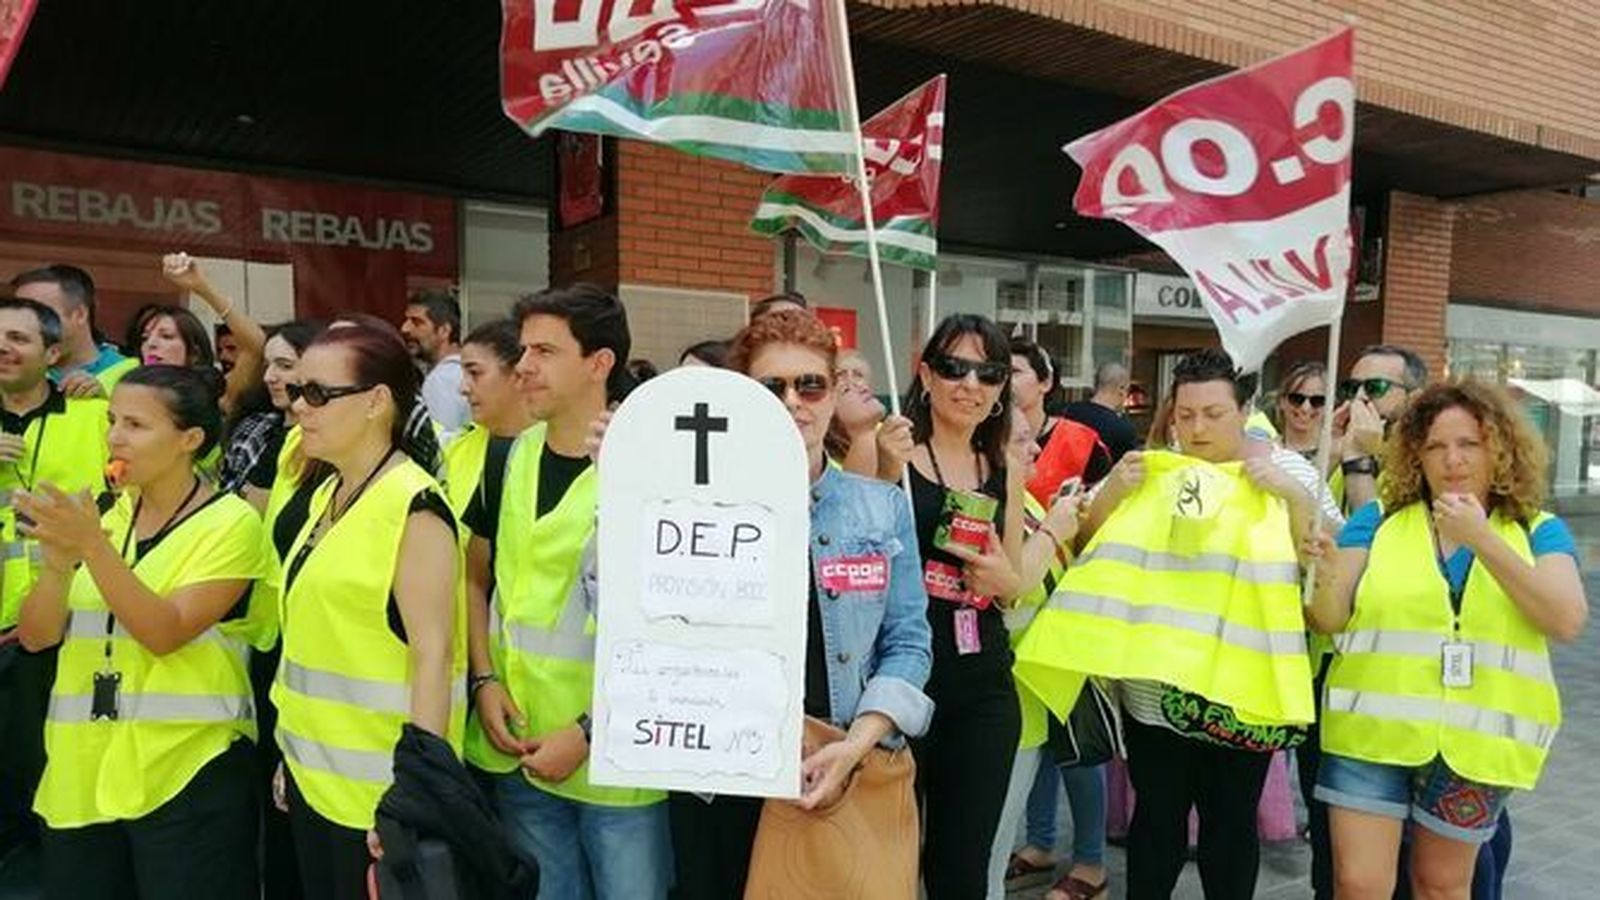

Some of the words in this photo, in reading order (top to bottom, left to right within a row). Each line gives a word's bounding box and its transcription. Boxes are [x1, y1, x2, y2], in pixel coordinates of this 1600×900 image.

[11, 180, 222, 236] REBAJAS
[260, 207, 434, 254] REBAJAS
[656, 518, 762, 563] D.E.P.
